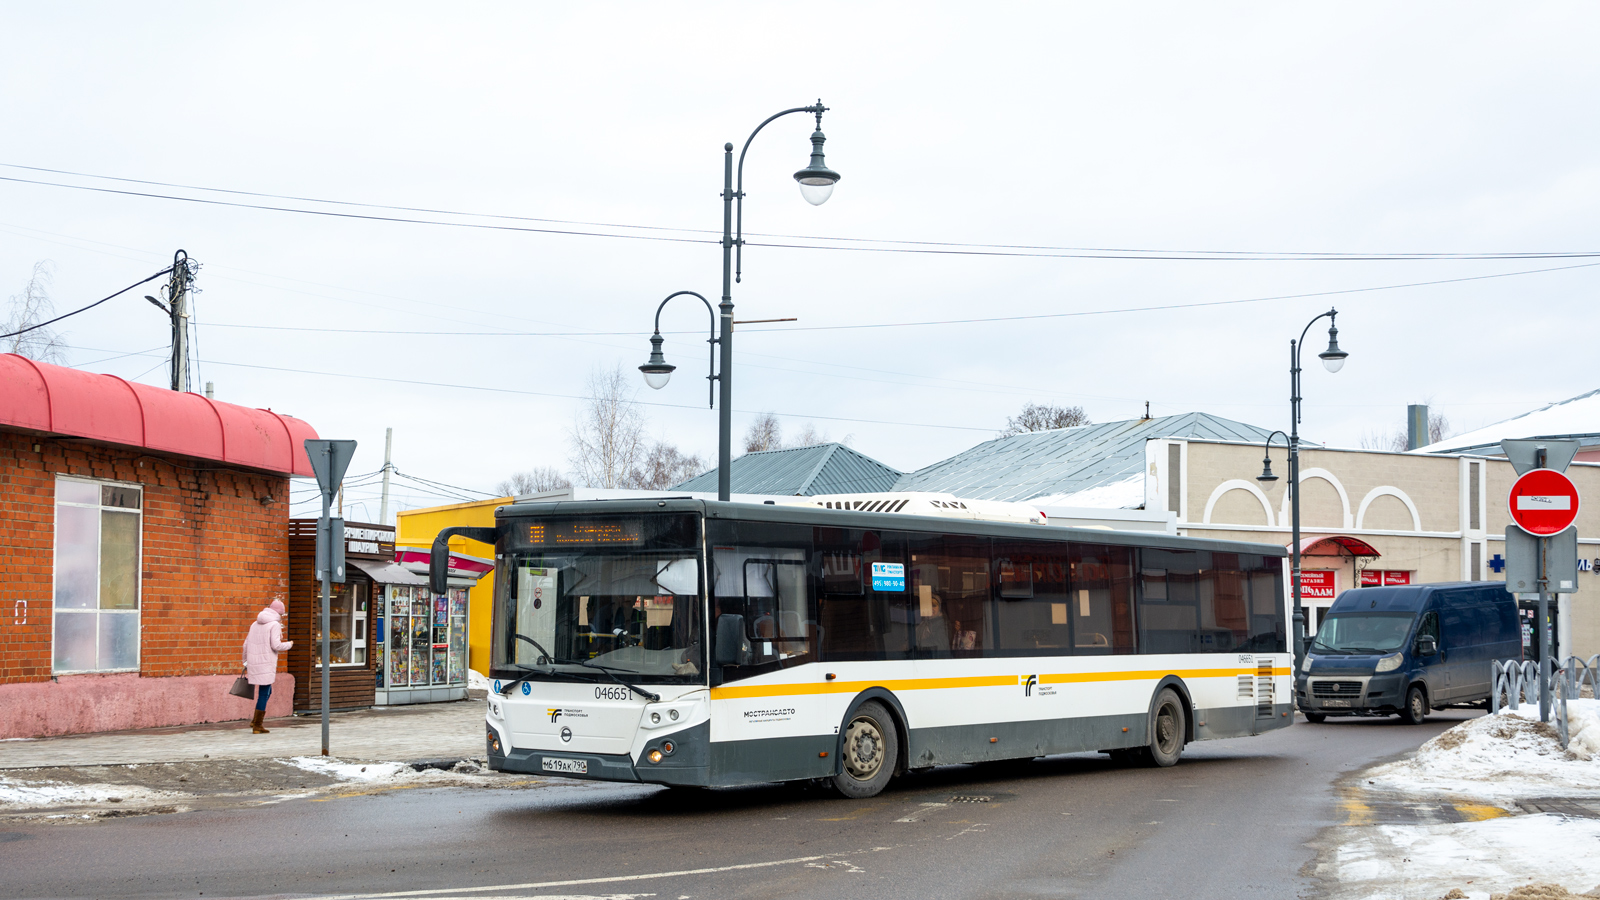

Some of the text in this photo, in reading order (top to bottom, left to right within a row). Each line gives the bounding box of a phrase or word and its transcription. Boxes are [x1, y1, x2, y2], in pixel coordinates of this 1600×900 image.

[349, 541, 379, 554] ШАУРМА
[594, 686, 633, 700] 046651
[743, 708, 795, 718] МОСТРАНСАВТО
